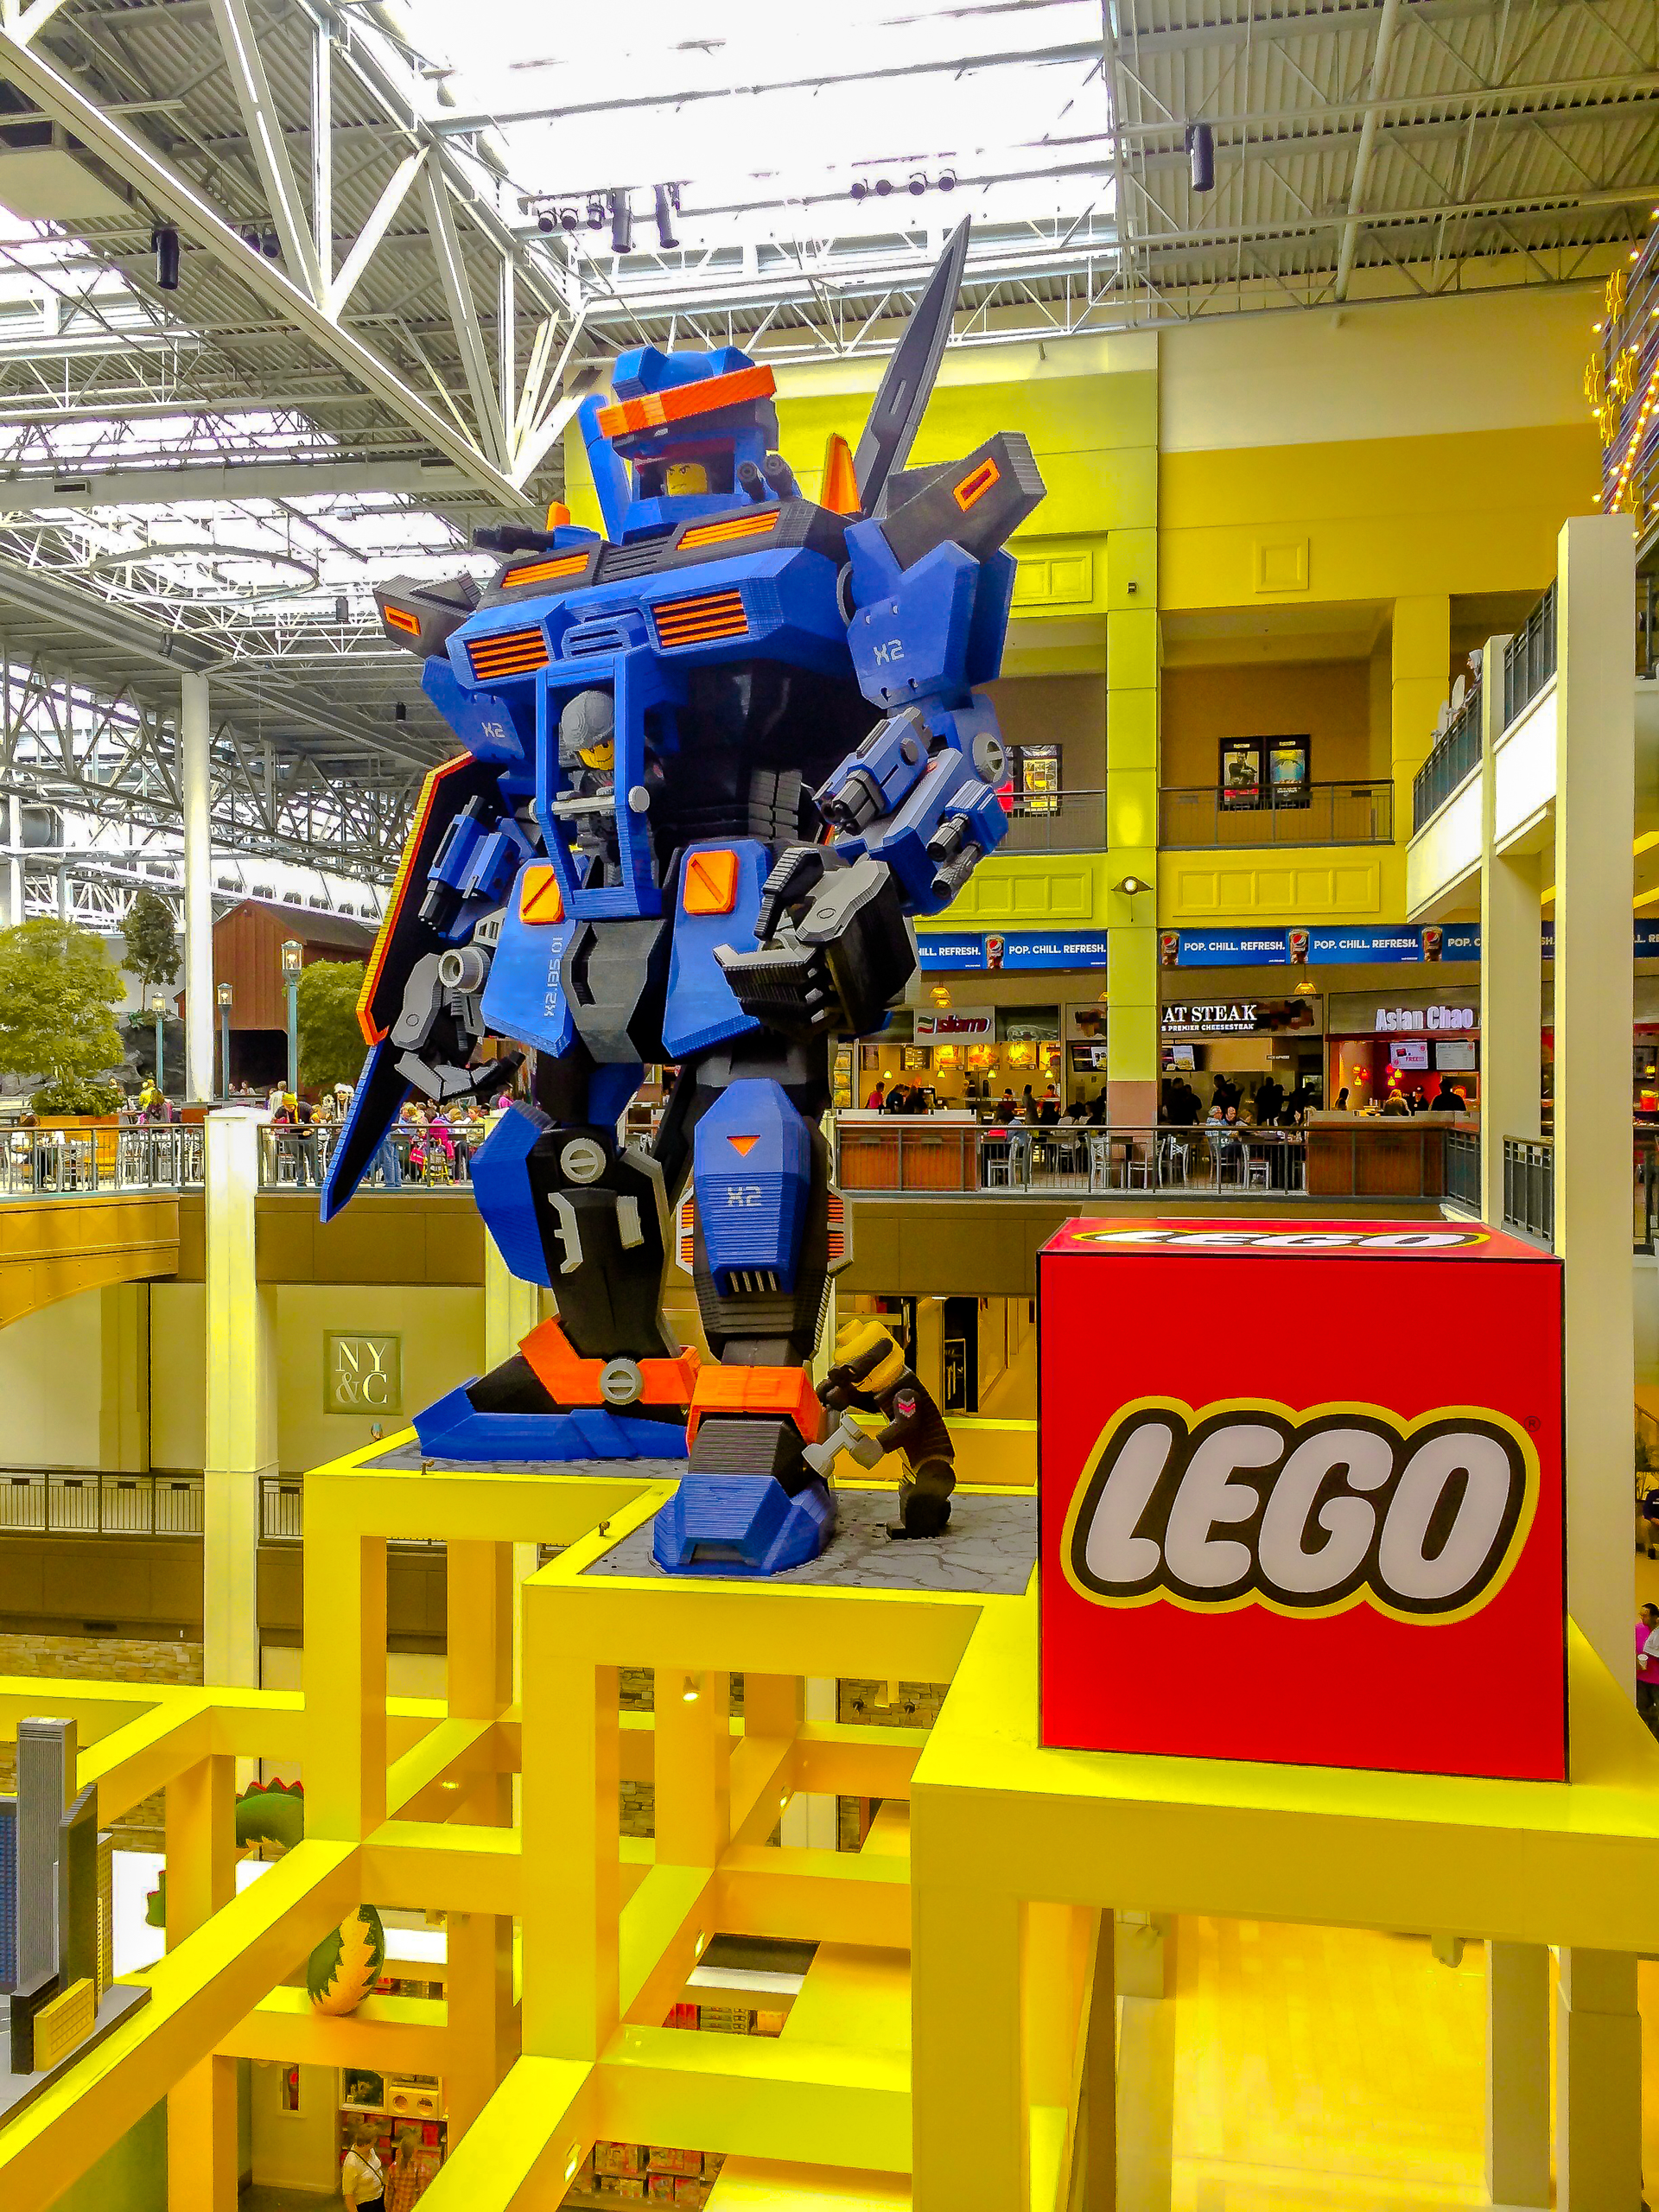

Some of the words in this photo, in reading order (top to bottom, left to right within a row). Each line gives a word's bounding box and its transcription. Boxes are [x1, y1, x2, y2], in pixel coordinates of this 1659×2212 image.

[918, 947, 938, 956] HILL.
[939, 946, 982, 956] REFRESH.
[1008, 946, 1031, 955] POP.
[1033, 945, 1061, 954] CHILL.
[1064, 944, 1107, 954] REFRESH.
[1184, 942, 1207, 951] POP.
[1208, 942, 1239, 950] CHILL.
[1241, 941, 1286, 950] REFRESH.
[1313, 940, 1337, 950] POP.
[1338, 939, 1370, 949] CHILL.
[1372, 938, 1419, 949] REFRESH.
[1447, 938, 1471, 947] POP.
[1161, 1007, 1187, 1023] AT
[1191, 1004, 1258, 1022] STEAK
[1375, 1007, 1424, 1031] Asian
[1427, 1006, 1474, 1029] Chao
[1085, 1230, 1478, 1248] LEGO
[335, 1341, 388, 1373] NY
[335, 1371, 388, 1405] &C
[1073, 1410, 1524, 1612] LEGO
